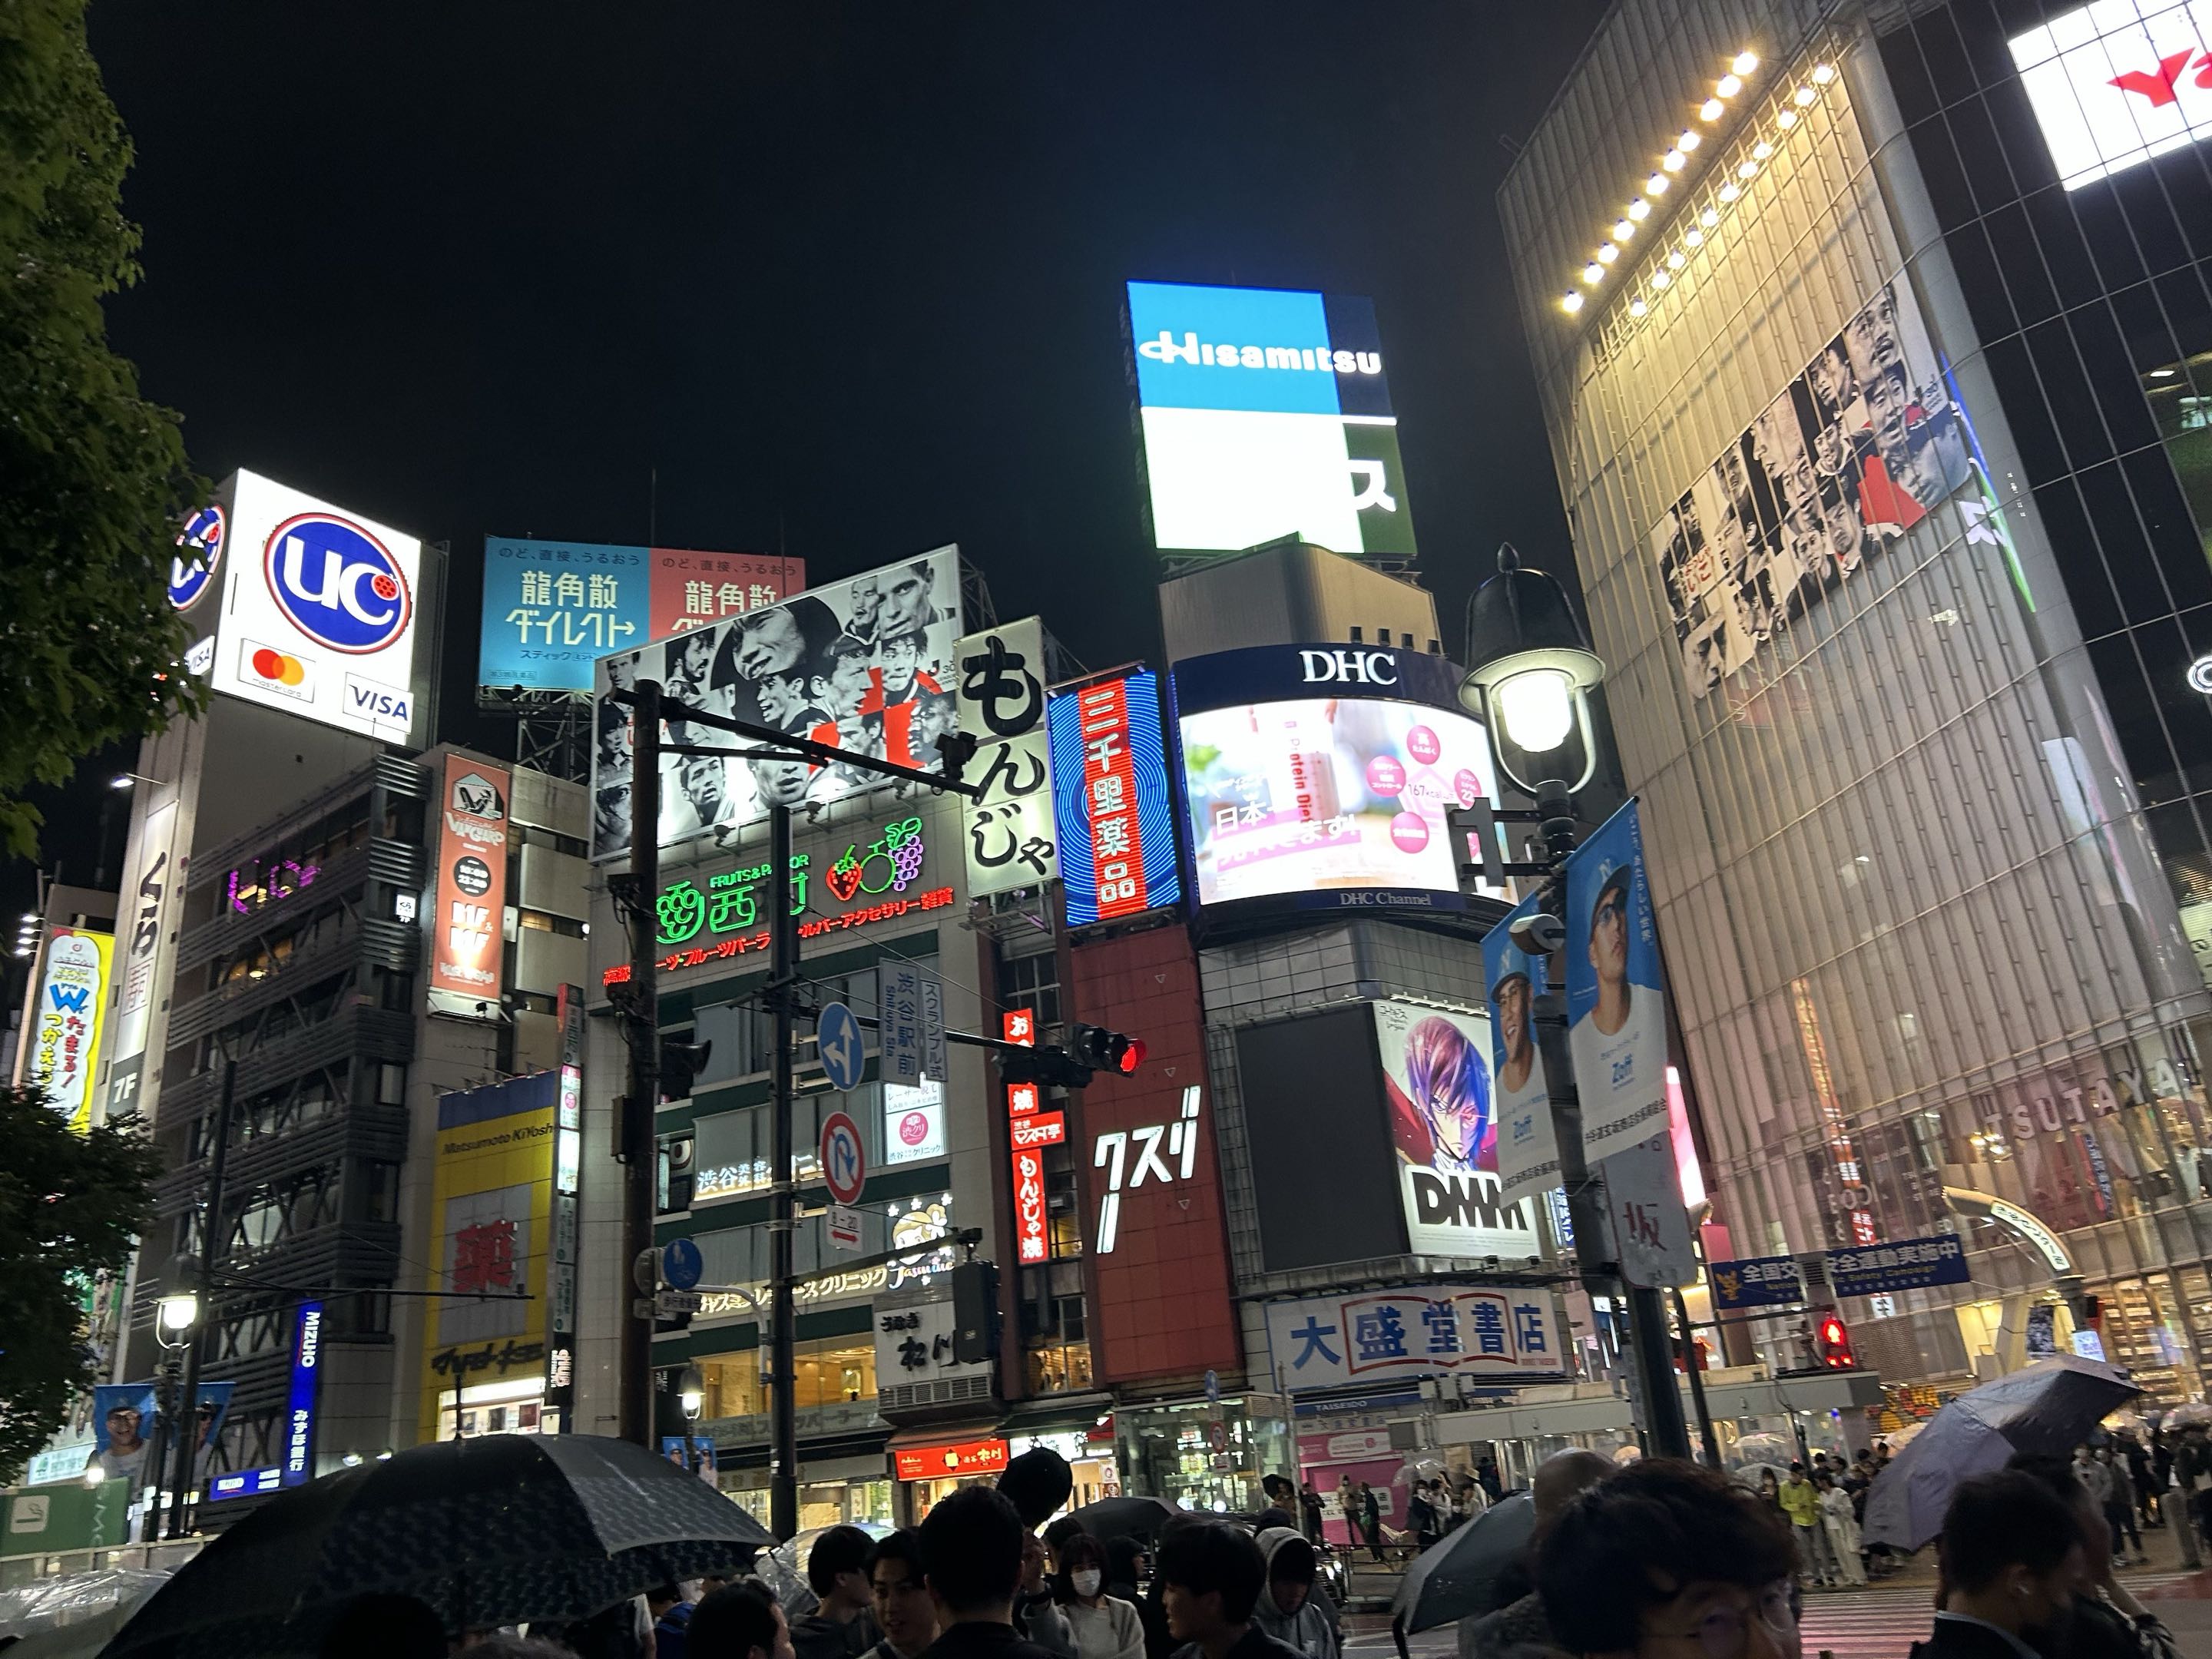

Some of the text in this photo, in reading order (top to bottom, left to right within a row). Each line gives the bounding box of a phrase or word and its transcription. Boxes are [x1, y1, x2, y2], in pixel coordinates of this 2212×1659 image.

[499, 547, 641, 566] のど、直接、うるおう
[662, 558, 796, 576] のど、直接、うるおう
[522, 570, 619, 609] 龍角散
[520, 649, 572, 661] スティック
[1298, 650, 1398, 685] DHC
[252, 678, 303, 698] mastercard
[348, 684, 409, 721] VISA
[962, 635, 1055, 876] もんじゃ
[1084, 690, 1137, 903] 三千里薬品
[1340, 892, 1432, 906] DHC Channel
[49, 984, 90, 1013] W
[884, 985, 896, 1032] Shibuya
[897, 972, 916, 1076] 渋谷駅前
[1008, 1015, 1035, 1112] お焼
[114, 1072, 137, 1103] 7F
[1982, 1058, 2182, 1144] TSUTAYA
[1013, 1119, 1031, 1130] 渋谷
[443, 1133, 511, 1154] Matsumoto
[1018, 1154, 1045, 1258] もんじゃ焼
[1741, 1240, 1959, 1284] 全国交安全運動実施中
[301, 1311, 321, 1368] MIZUHO
[1290, 1301, 1547, 1371] 大盛堂書店
[1315, 1399, 1368, 1412] TAISEIDO
